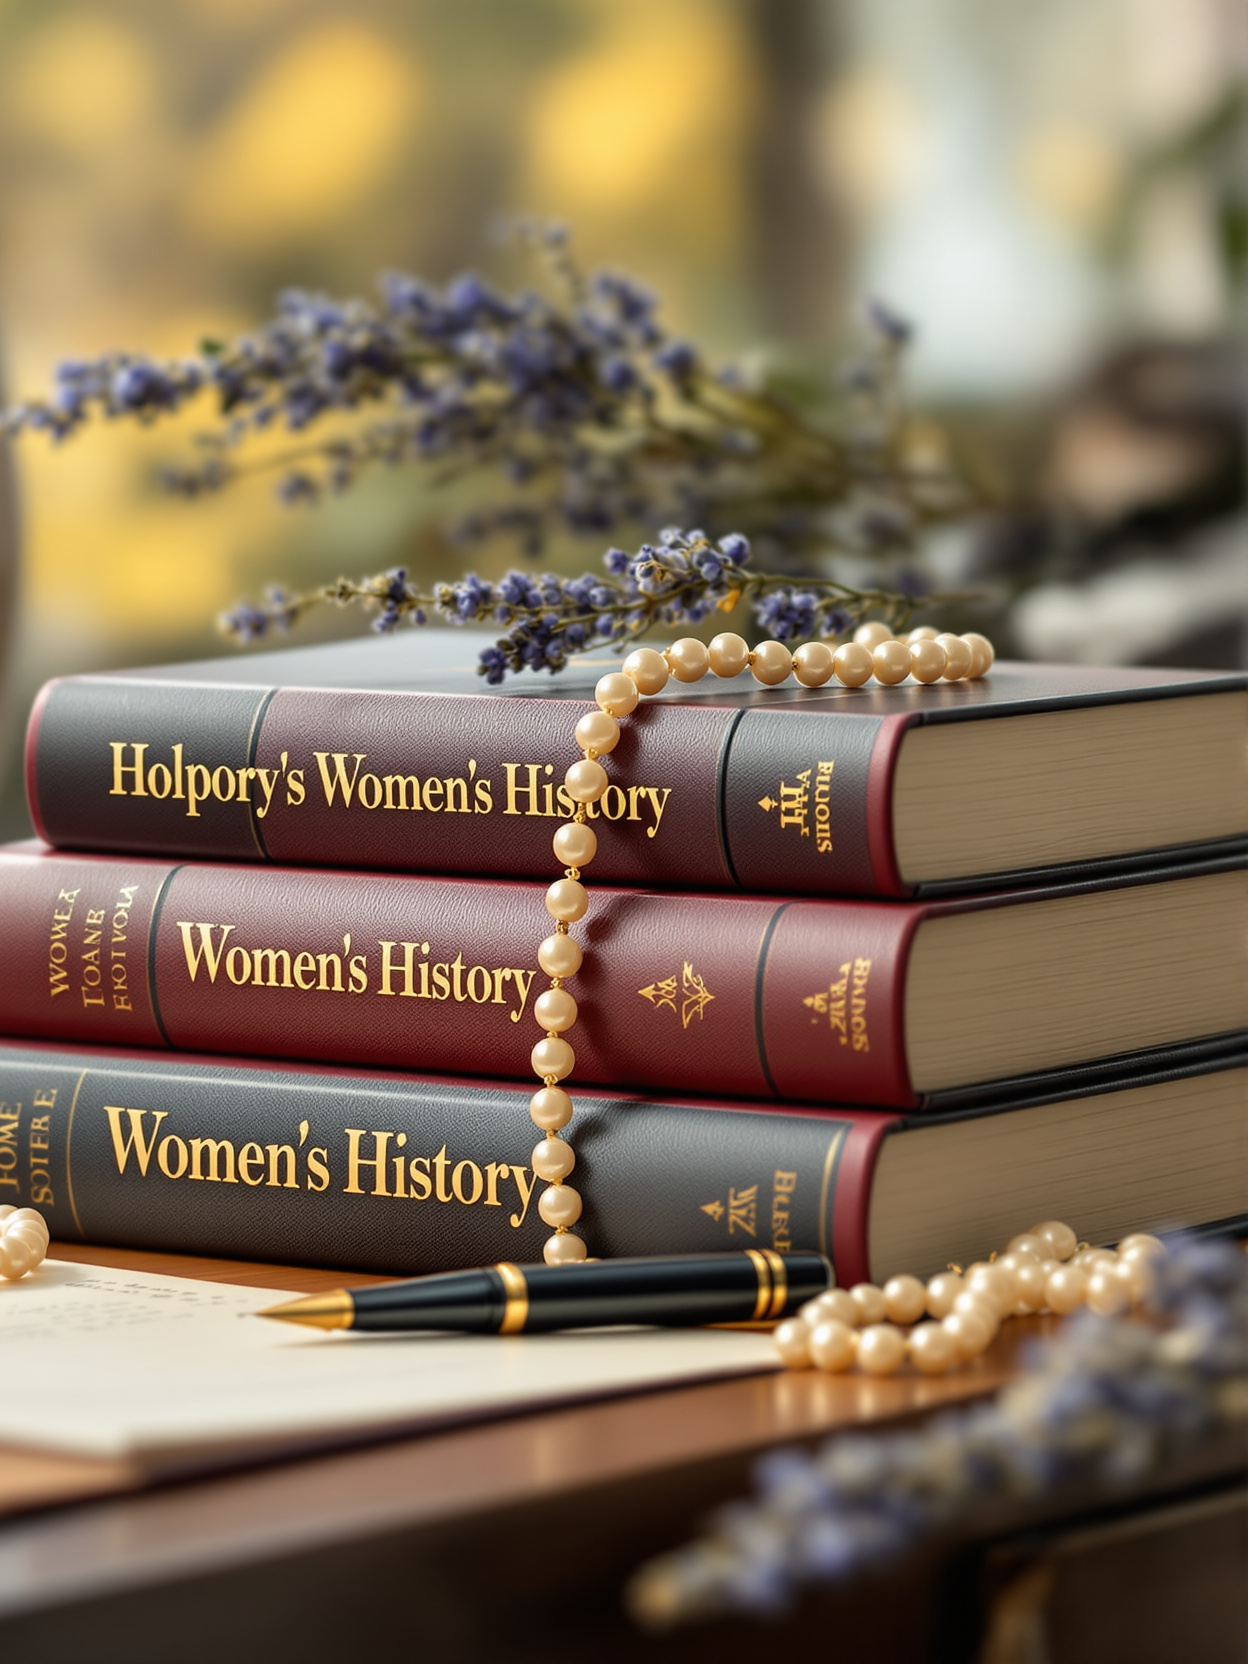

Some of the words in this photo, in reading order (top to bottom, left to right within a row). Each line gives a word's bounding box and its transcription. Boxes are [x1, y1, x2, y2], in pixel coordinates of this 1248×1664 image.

[109, 741, 306, 819] Holpory's
[313, 751, 492, 815] Women's
[176, 921, 368, 994] Women's
[376, 940, 537, 1023] History
[103, 1106, 330, 1192] Women's
[342, 1128, 538, 1228] History
